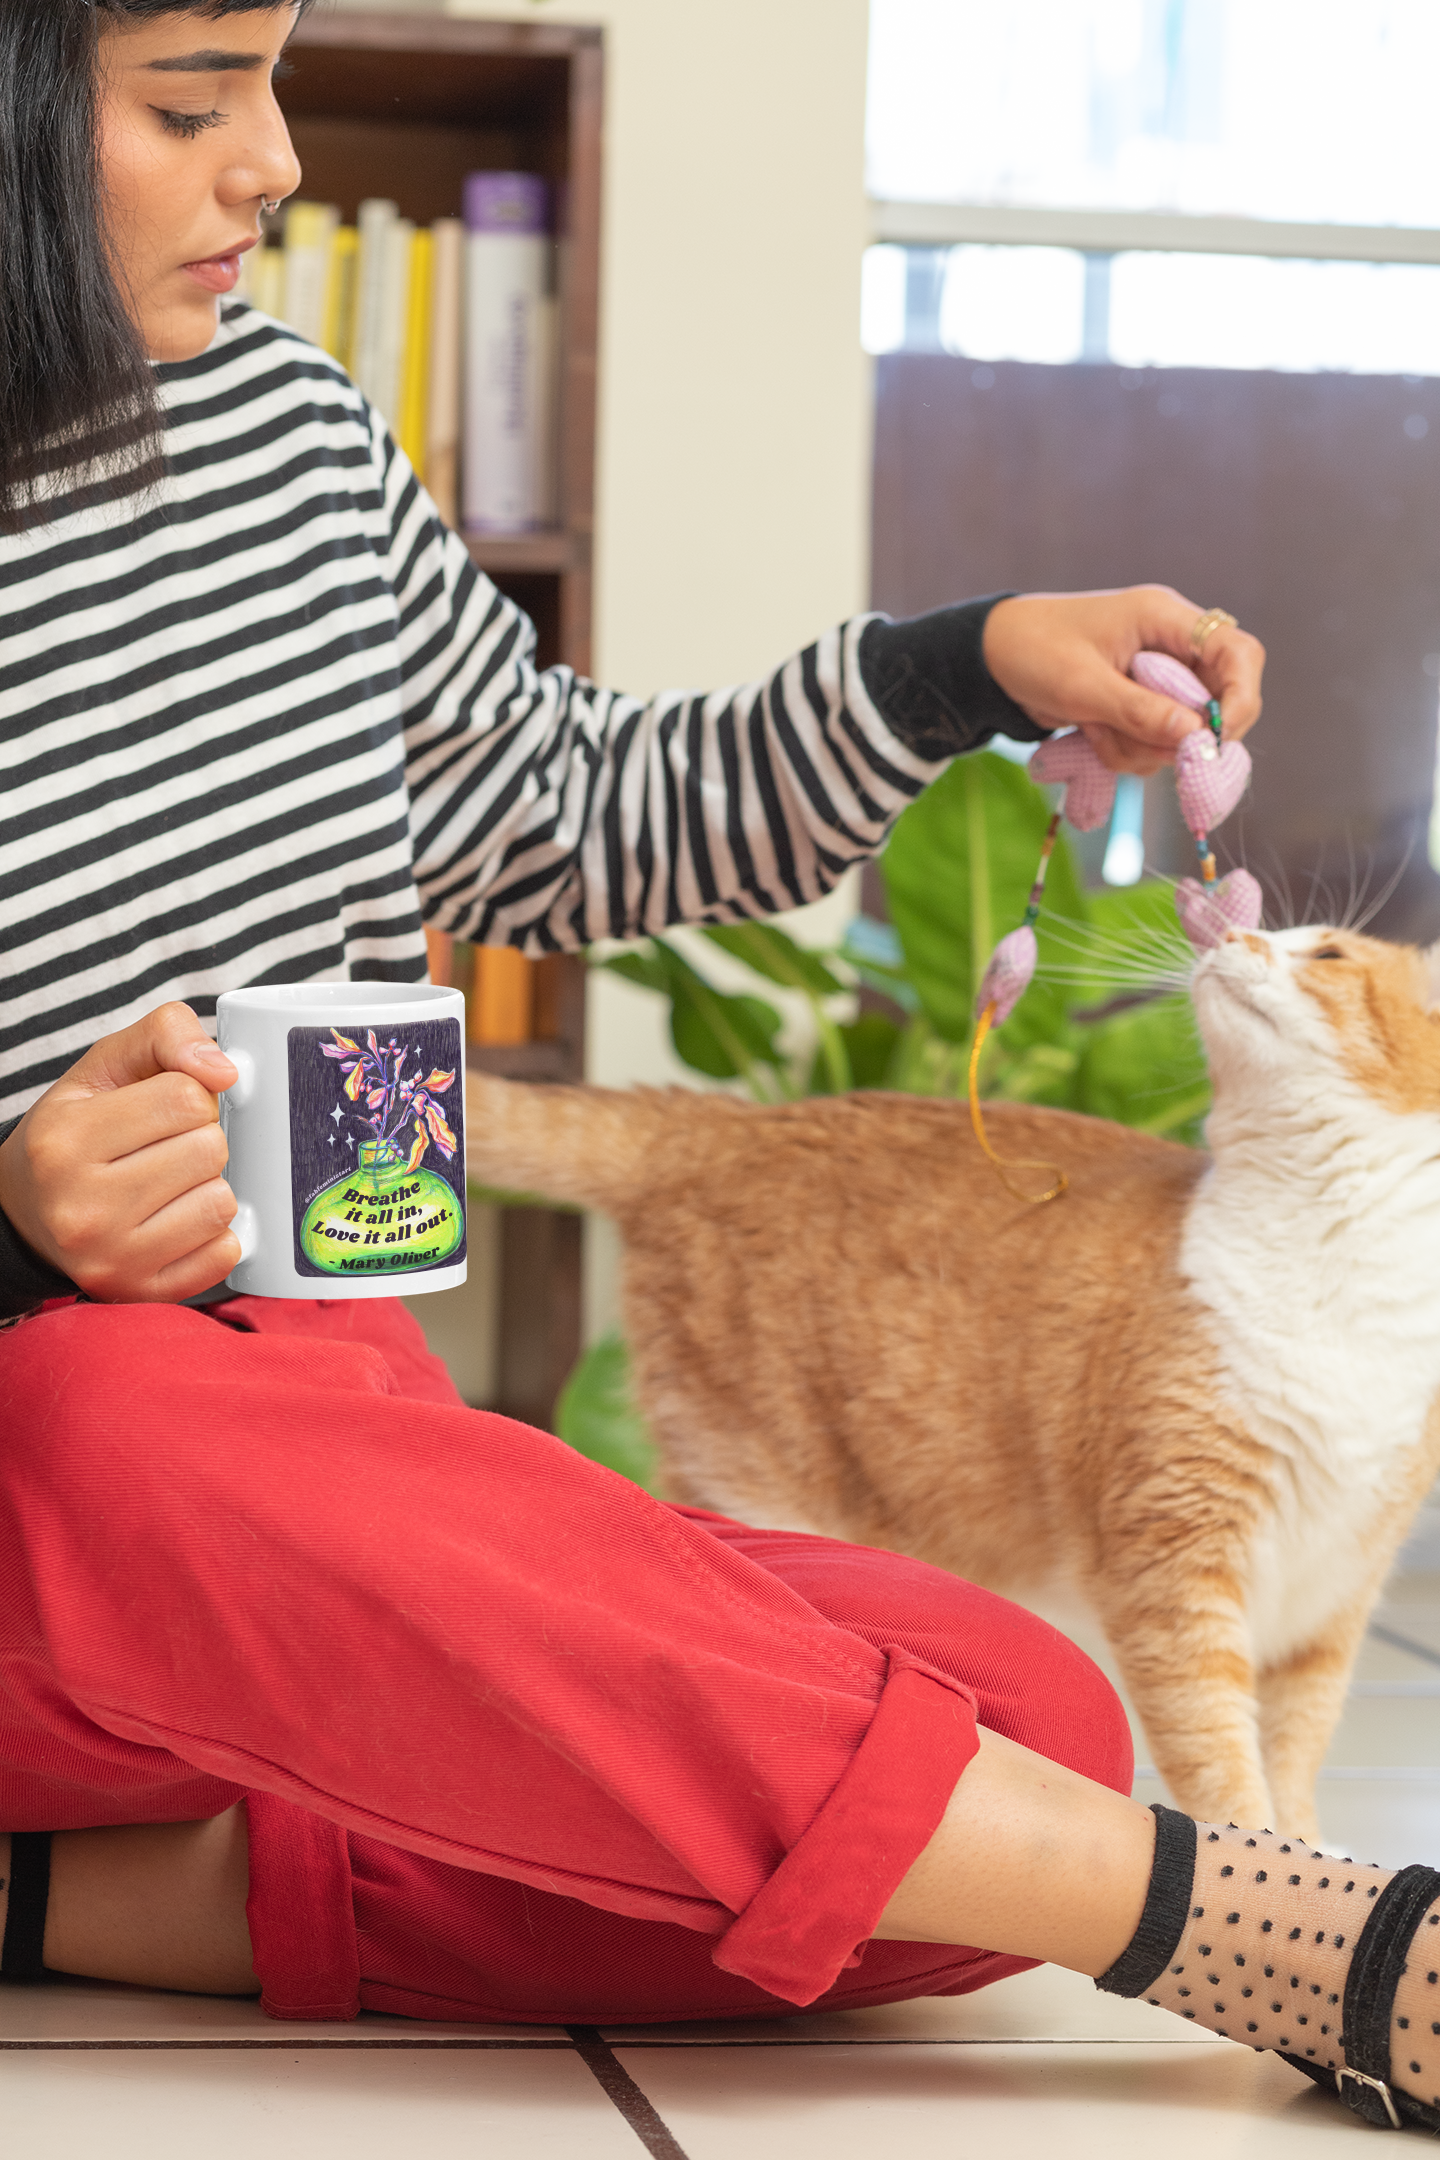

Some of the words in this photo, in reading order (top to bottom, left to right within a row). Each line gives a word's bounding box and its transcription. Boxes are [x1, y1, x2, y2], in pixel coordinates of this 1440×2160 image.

[342, 1182, 421, 1206] Breathe
[311, 1221, 360, 1243] Love
[364, 1230, 381, 1244] it
[385, 1224, 412, 1243] all
[415, 1208, 453, 1234] out.
[344, 1207, 363, 1223] it
[365, 1209, 393, 1225] all
[397, 1205, 423, 1221] in,
[339, 1258, 386, 1270] Mary
[390, 1246, 440, 1266] Oliver
